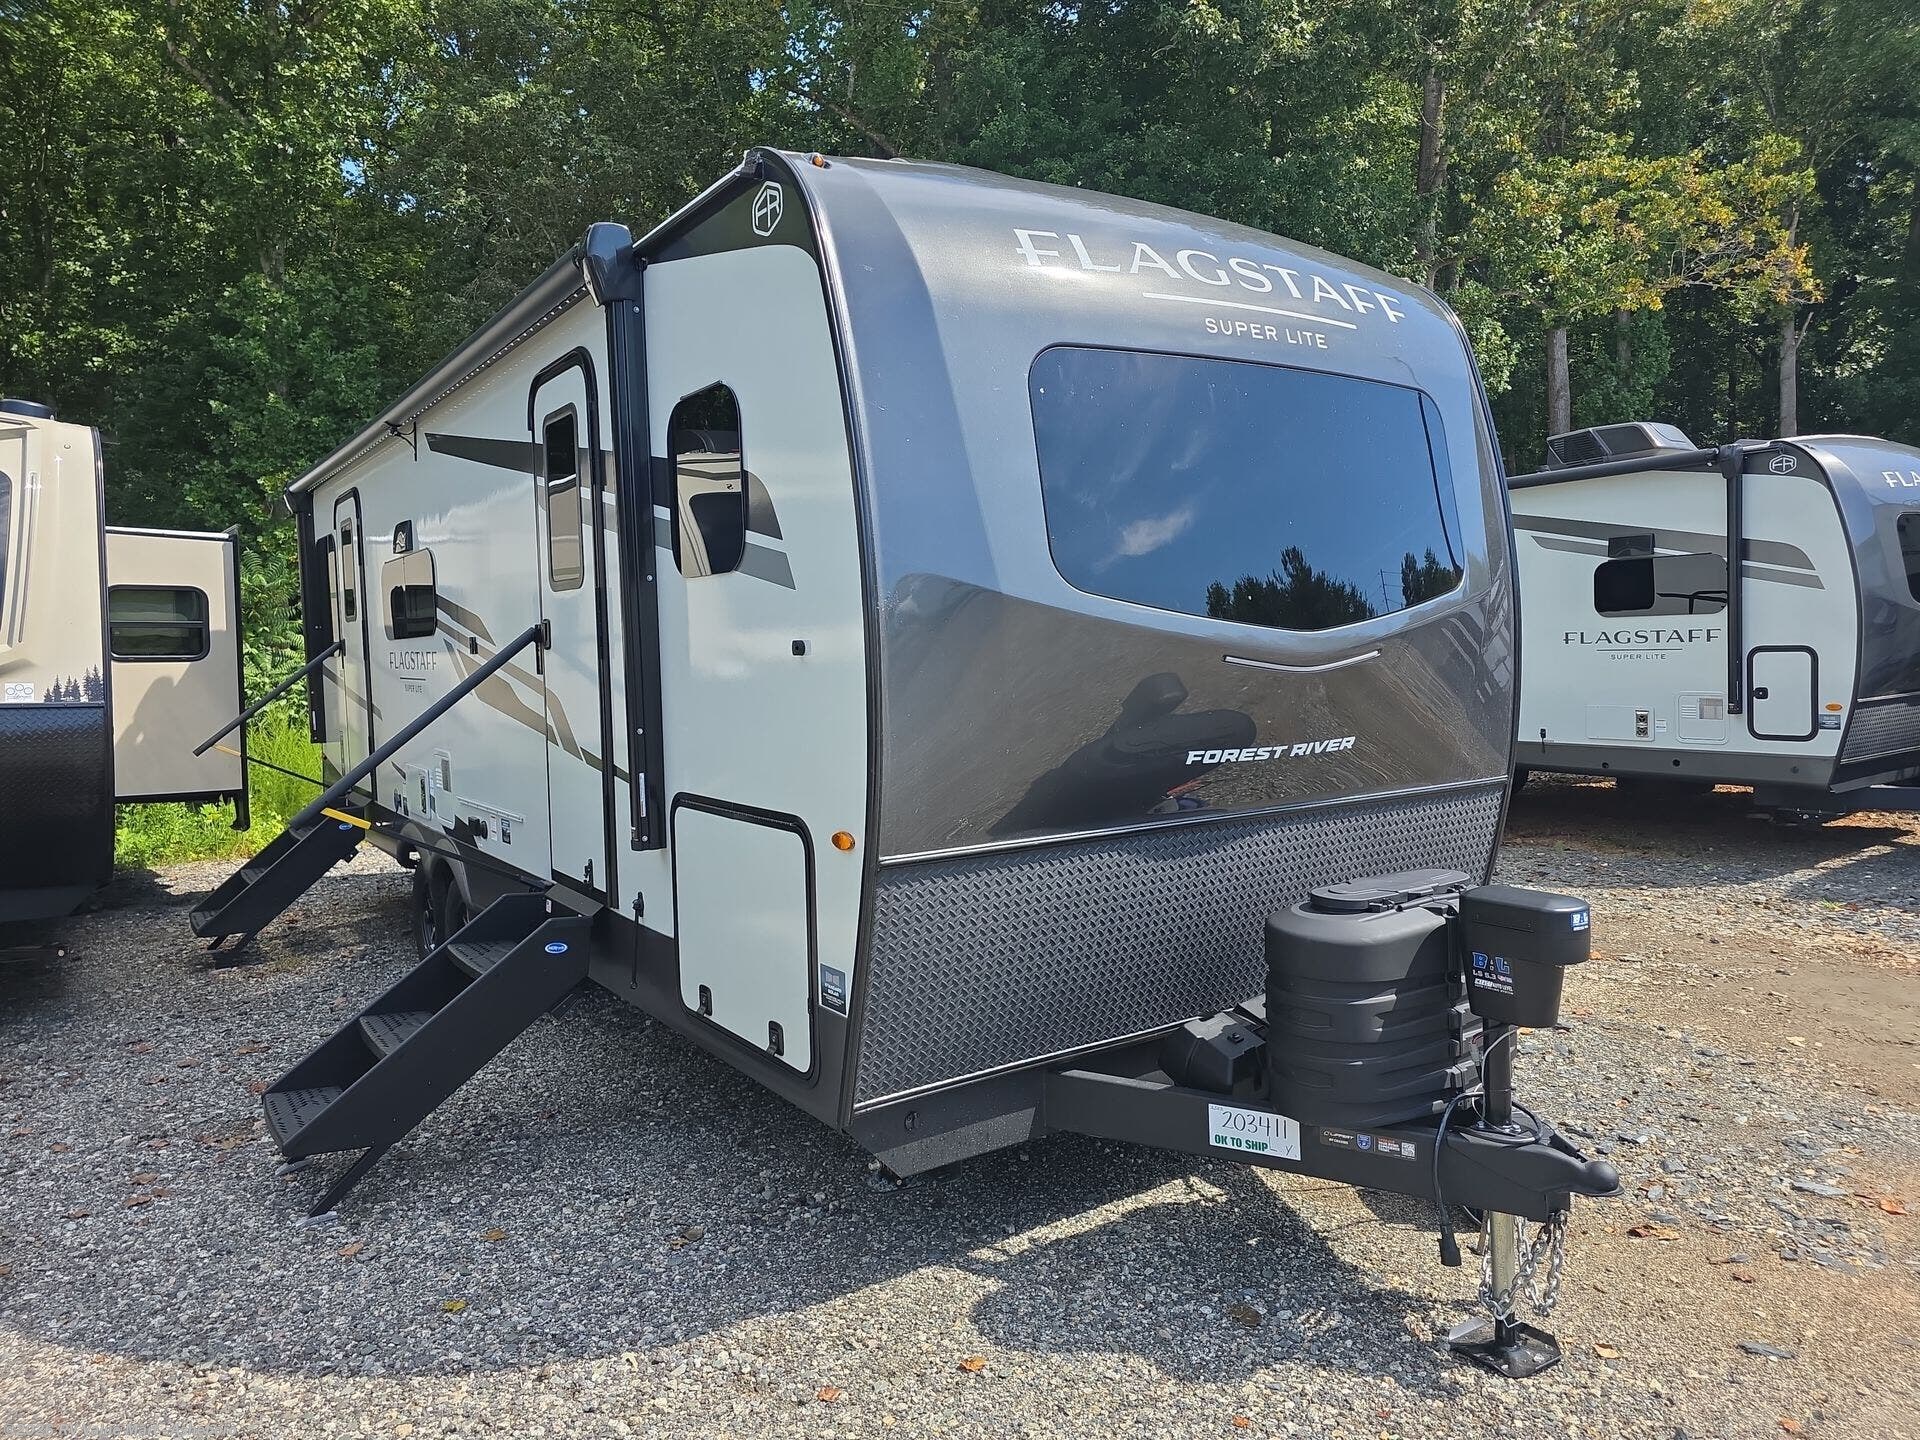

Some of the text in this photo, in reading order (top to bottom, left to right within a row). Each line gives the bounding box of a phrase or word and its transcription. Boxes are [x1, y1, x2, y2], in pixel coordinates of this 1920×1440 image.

[1012, 228, 1406, 324] FLAGSTAFF
[1205, 317, 1328, 350] SUPER LITE
[1563, 628, 1722, 645] FLAGSTAFF
[389, 651, 437, 670] FLAGSTAFF
[1185, 736, 1356, 765] FOREST RIVER
[1222, 1110, 1287, 1139] 203411
[1214, 1134, 1269, 1152] OK TO SHIP
